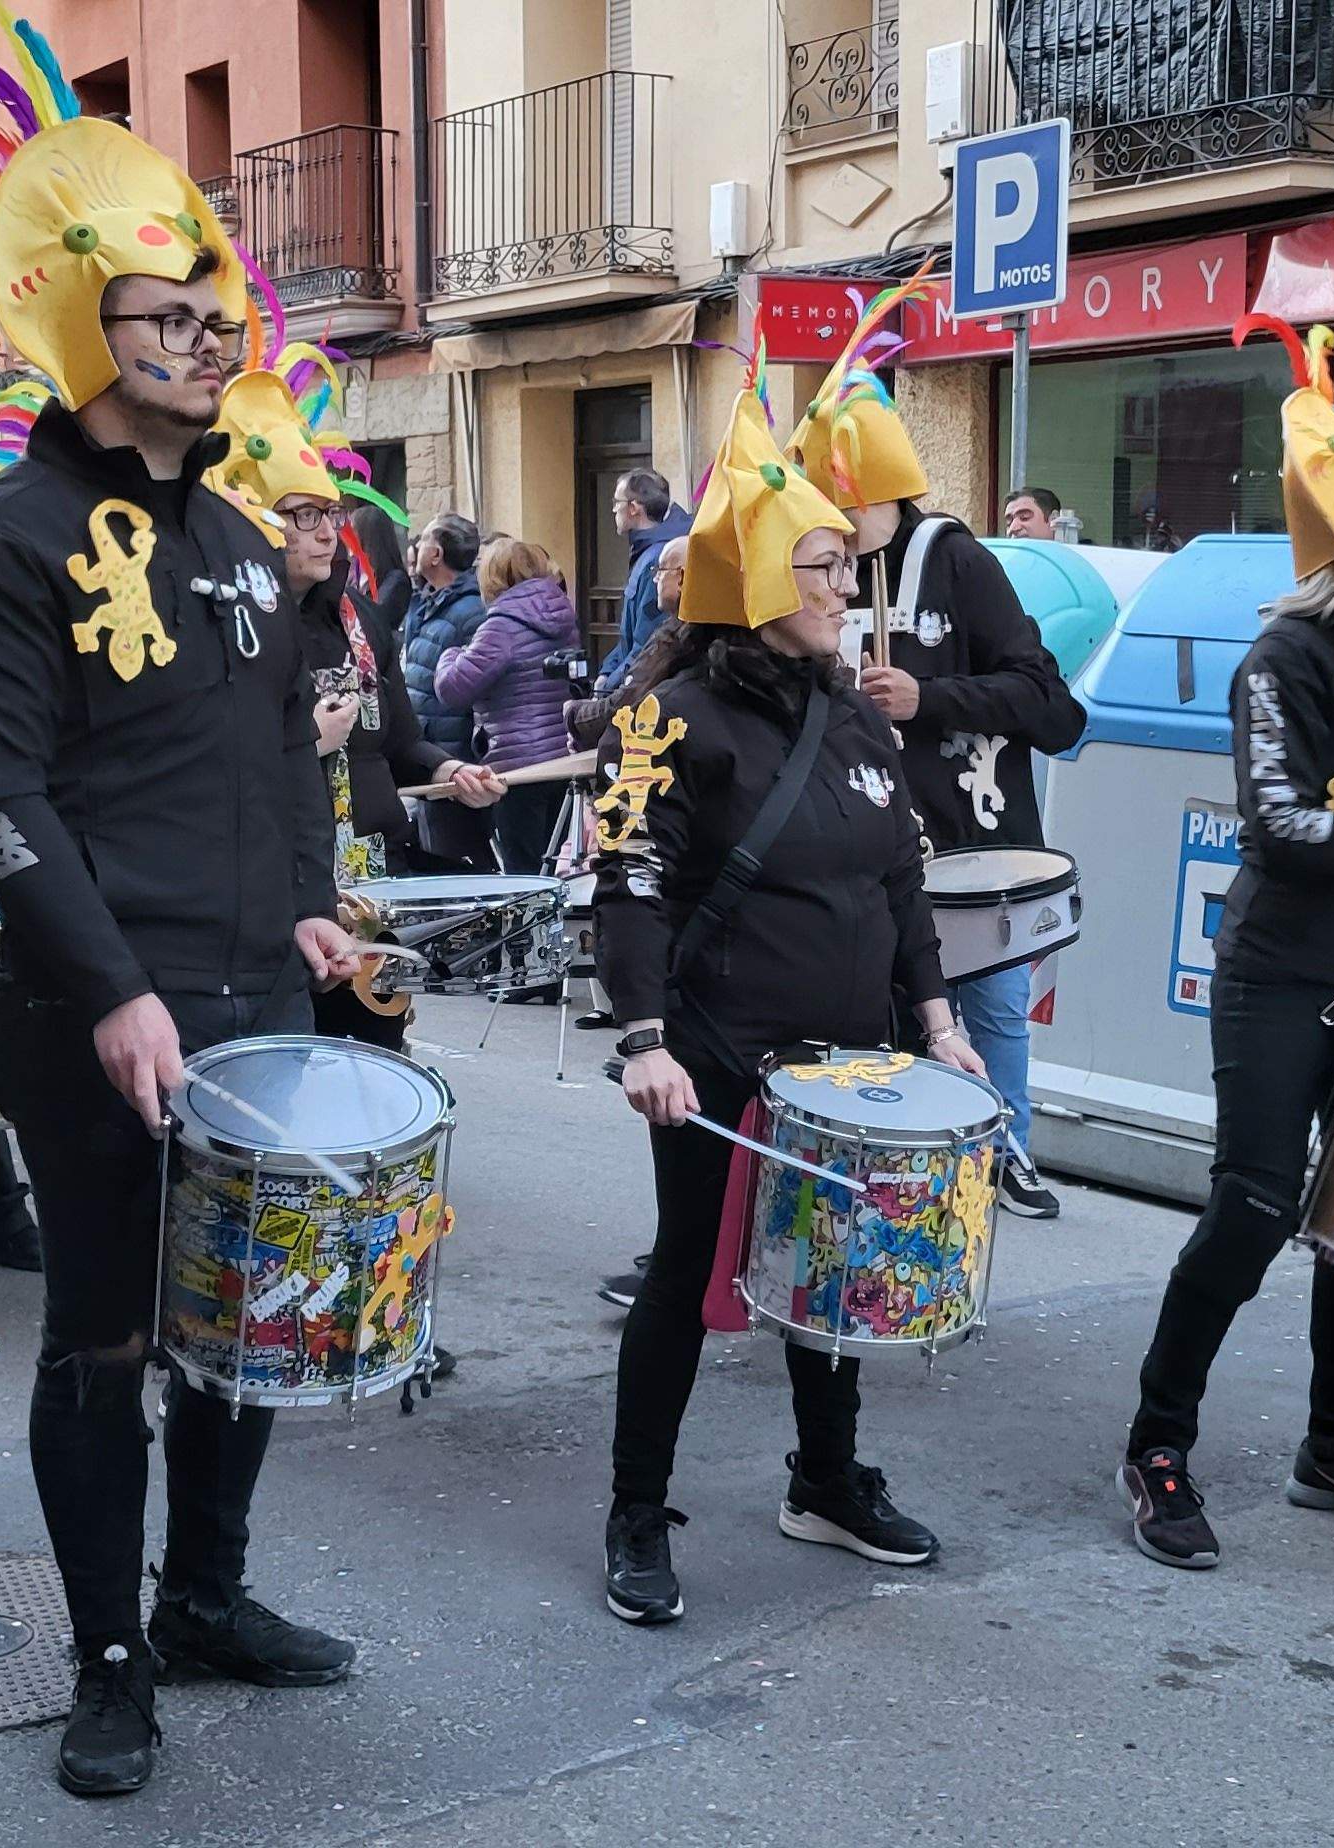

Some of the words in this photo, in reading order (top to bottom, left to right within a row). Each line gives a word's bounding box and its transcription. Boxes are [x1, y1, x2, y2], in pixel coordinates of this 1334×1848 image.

[974, 152, 1039, 294] P
[935, 257, 1223, 338] MORY
[999, 263, 1052, 289] MOTOS
[772, 305, 854, 319] MEMOR
